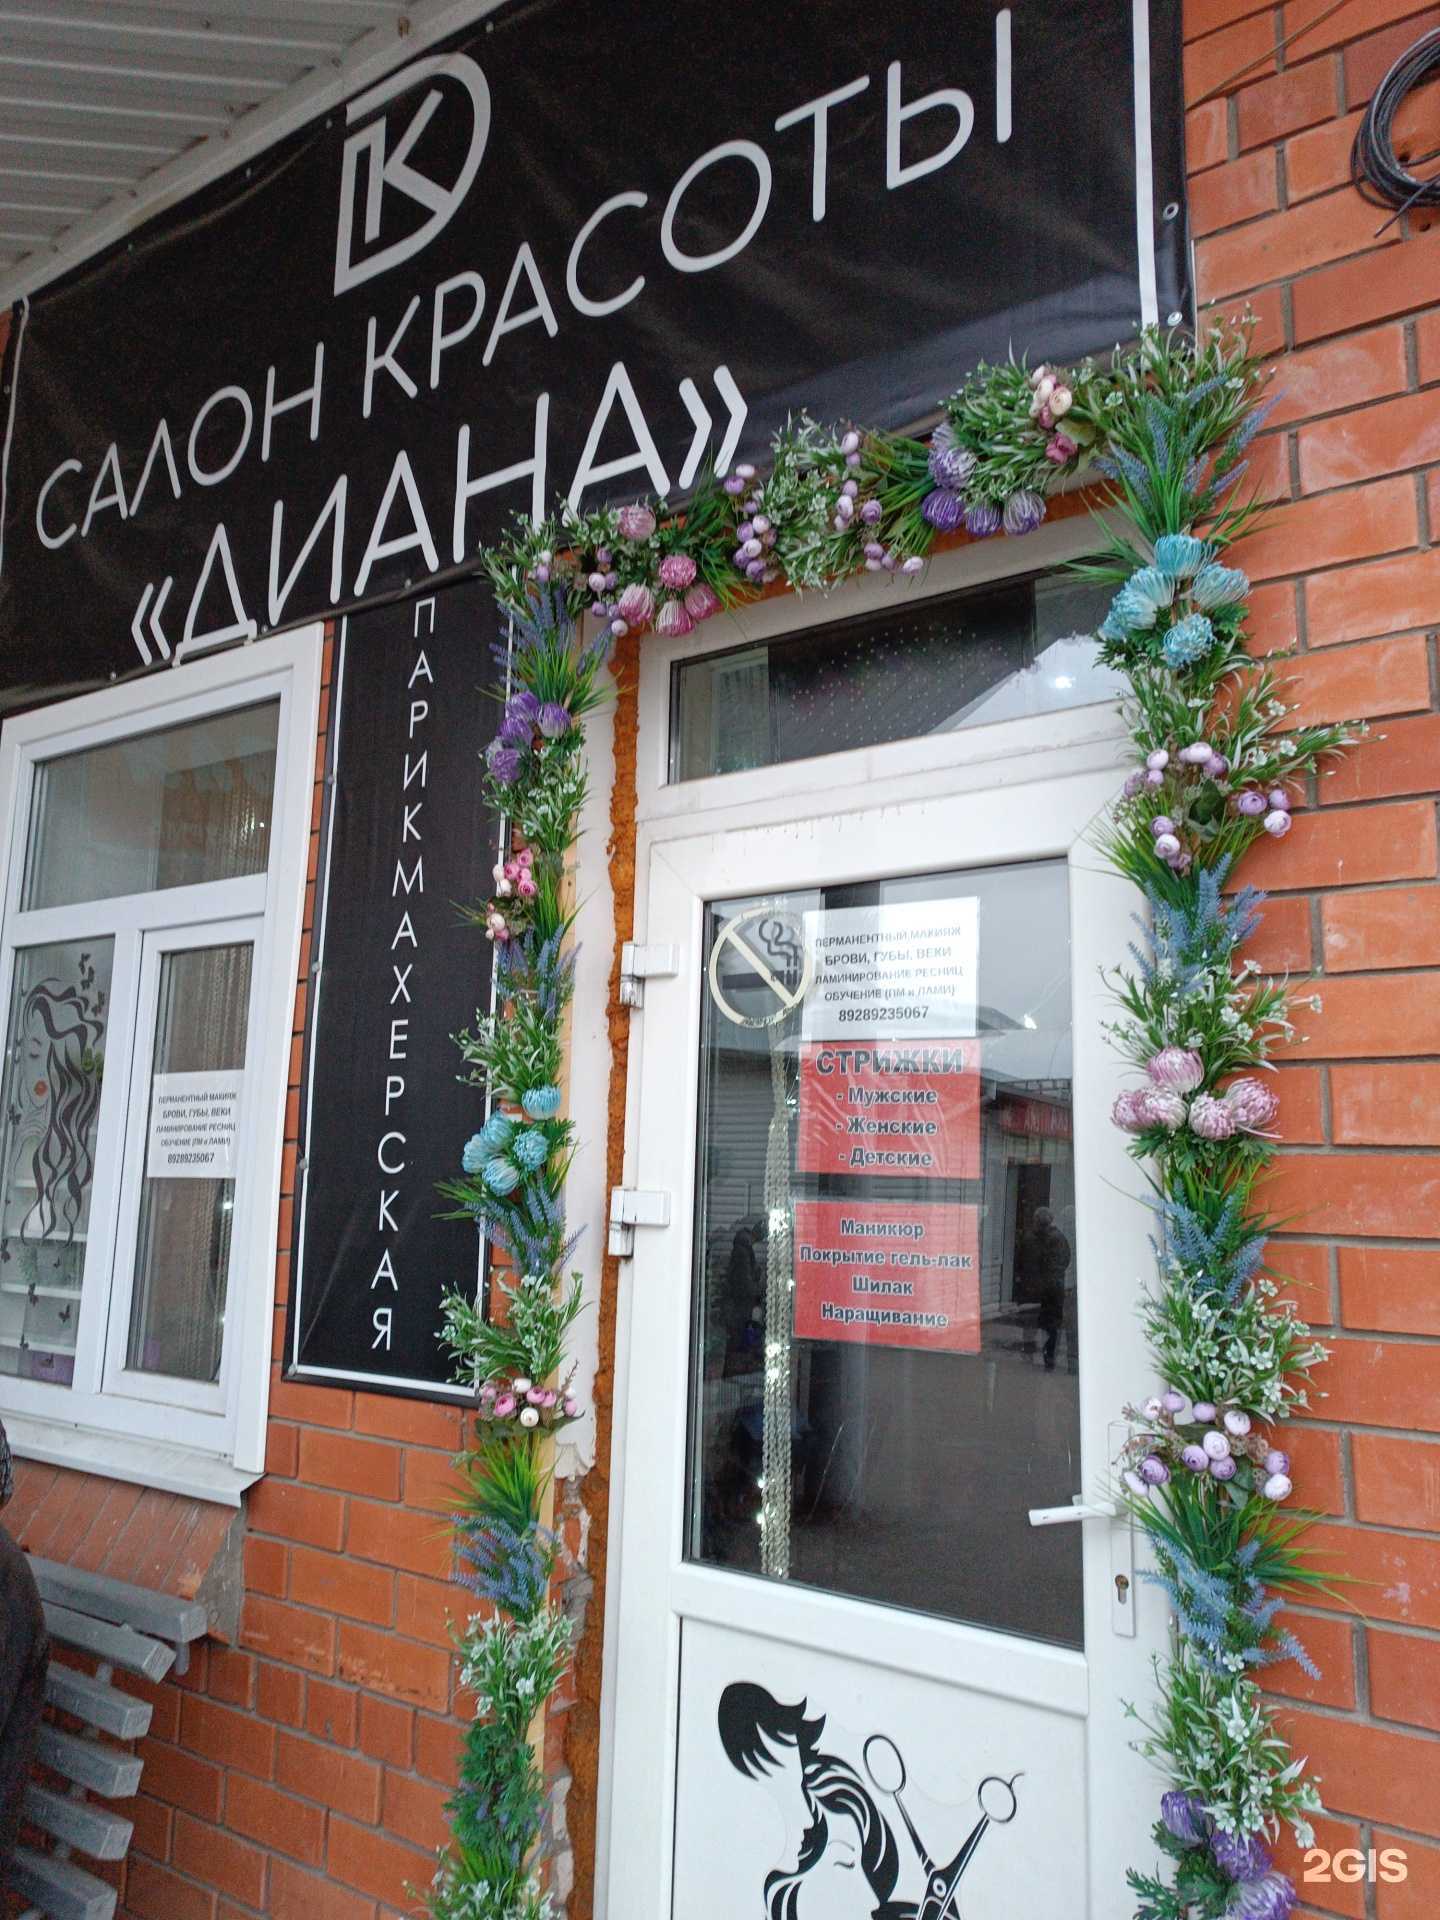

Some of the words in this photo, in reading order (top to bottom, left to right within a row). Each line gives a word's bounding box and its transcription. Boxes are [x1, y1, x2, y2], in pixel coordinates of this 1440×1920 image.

[36, 341, 324, 549] САЛОН
[363, 8, 1012, 419] КРАСОТЫ
[131, 360, 748, 667] «ДИАНА»
[815, 931, 908, 948] ПЕРМАНЕНТНЫЙ
[910, 925, 962, 941] МАКИЯЖ
[825, 952, 871, 967] БРОВИ,
[873, 949, 912, 963] ГУБЫ,
[916, 945, 952, 959] ВЕКИ
[371, 597, 436, 1351] ПАРИКМАХЕРСКАЯ
[815, 968, 912, 985] ЛАМИНИРОВАНИЕ
[915, 966, 964, 979] РЕСНИЦ
[824, 987, 882, 1002] ОБУЧЕНИЕ
[838, 1005, 929, 1022] 89289235067
[816, 1048, 963, 1075] СТРИЖКИ
[848, 1086, 937, 1107] Мужские
[847, 1115, 938, 1136] Женские
[850, 1147, 933, 1168] Детские
[841, 1219, 925, 1239] Маникюр
[799, 1245, 885, 1265] Покрытие
[890, 1252, 973, 1269] гель-лак
[852, 1275, 914, 1295] Шилак
[821, 1303, 949, 1328] Наращивание
